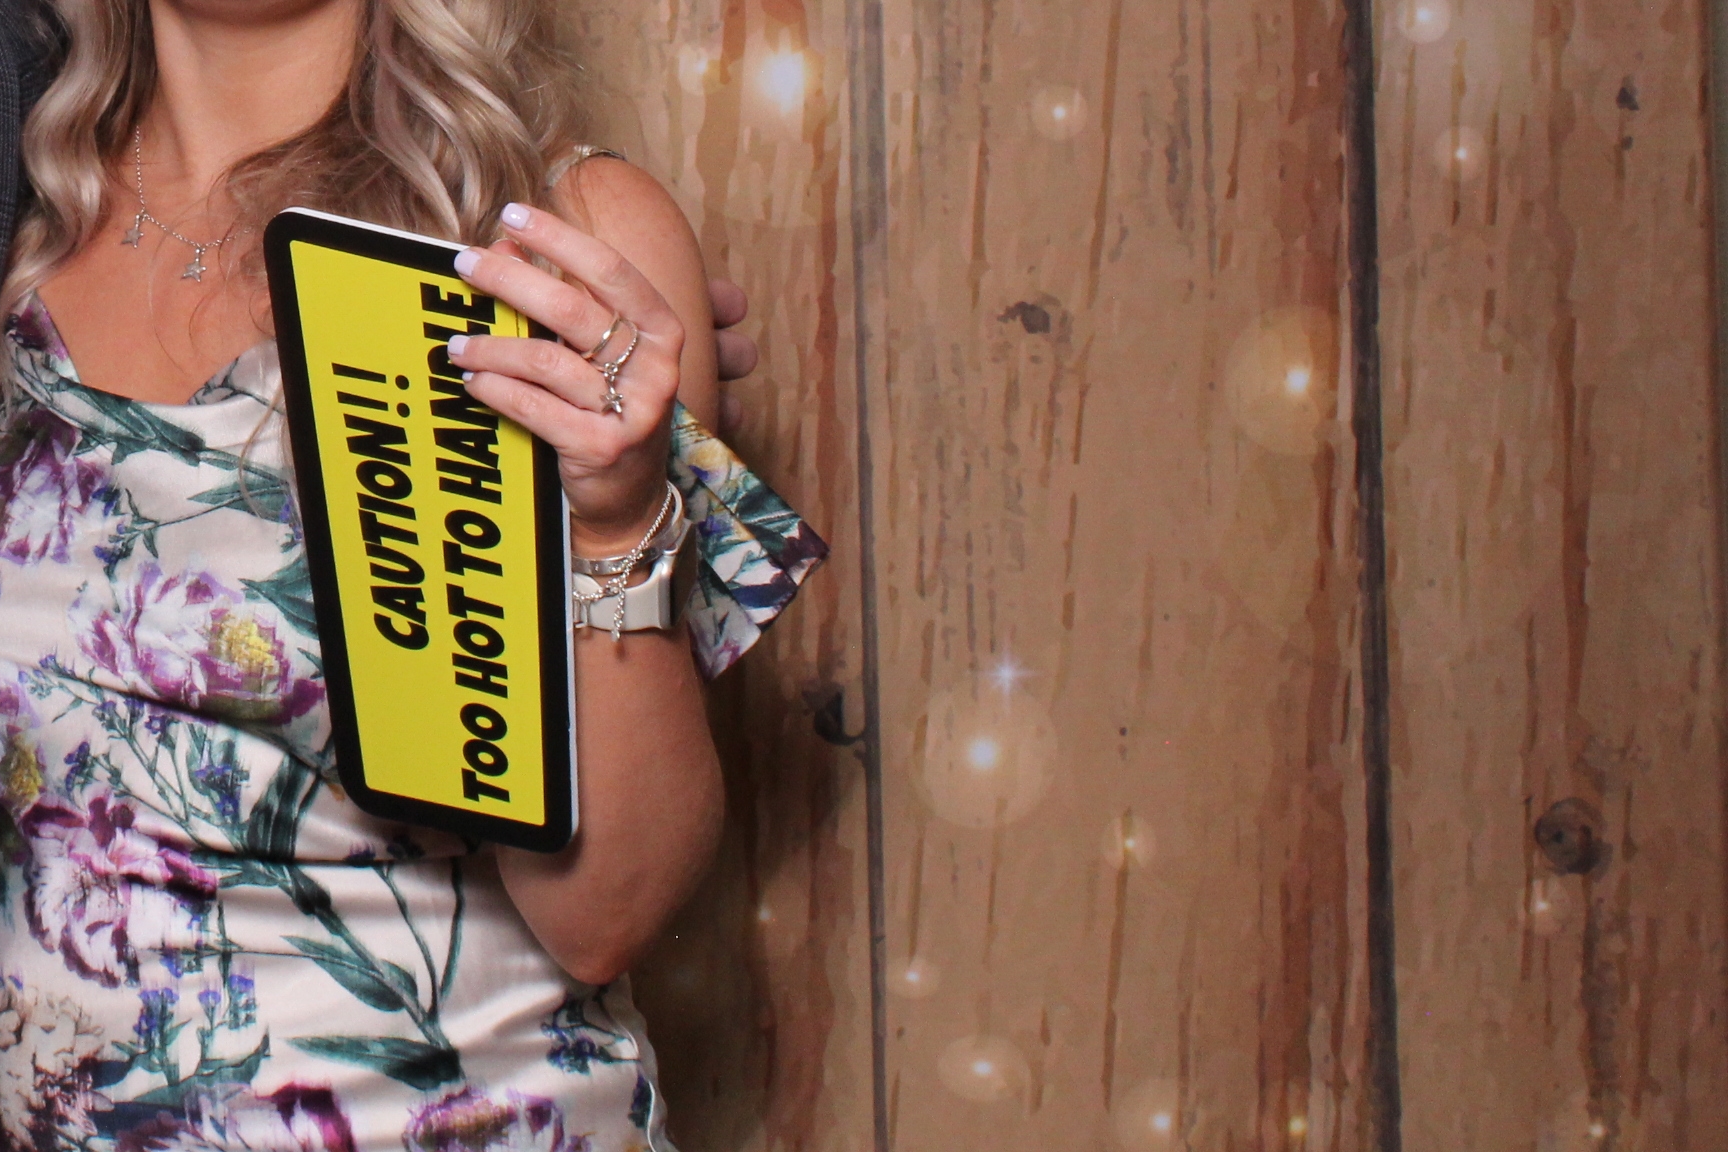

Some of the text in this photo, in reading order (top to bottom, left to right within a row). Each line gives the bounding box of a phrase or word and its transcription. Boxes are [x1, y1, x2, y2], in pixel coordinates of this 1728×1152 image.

[331, 363, 430, 651] CAUTION!!
[442, 509, 503, 577] TO
[445, 583, 508, 699] HOT
[459, 702, 510, 803] TOO
